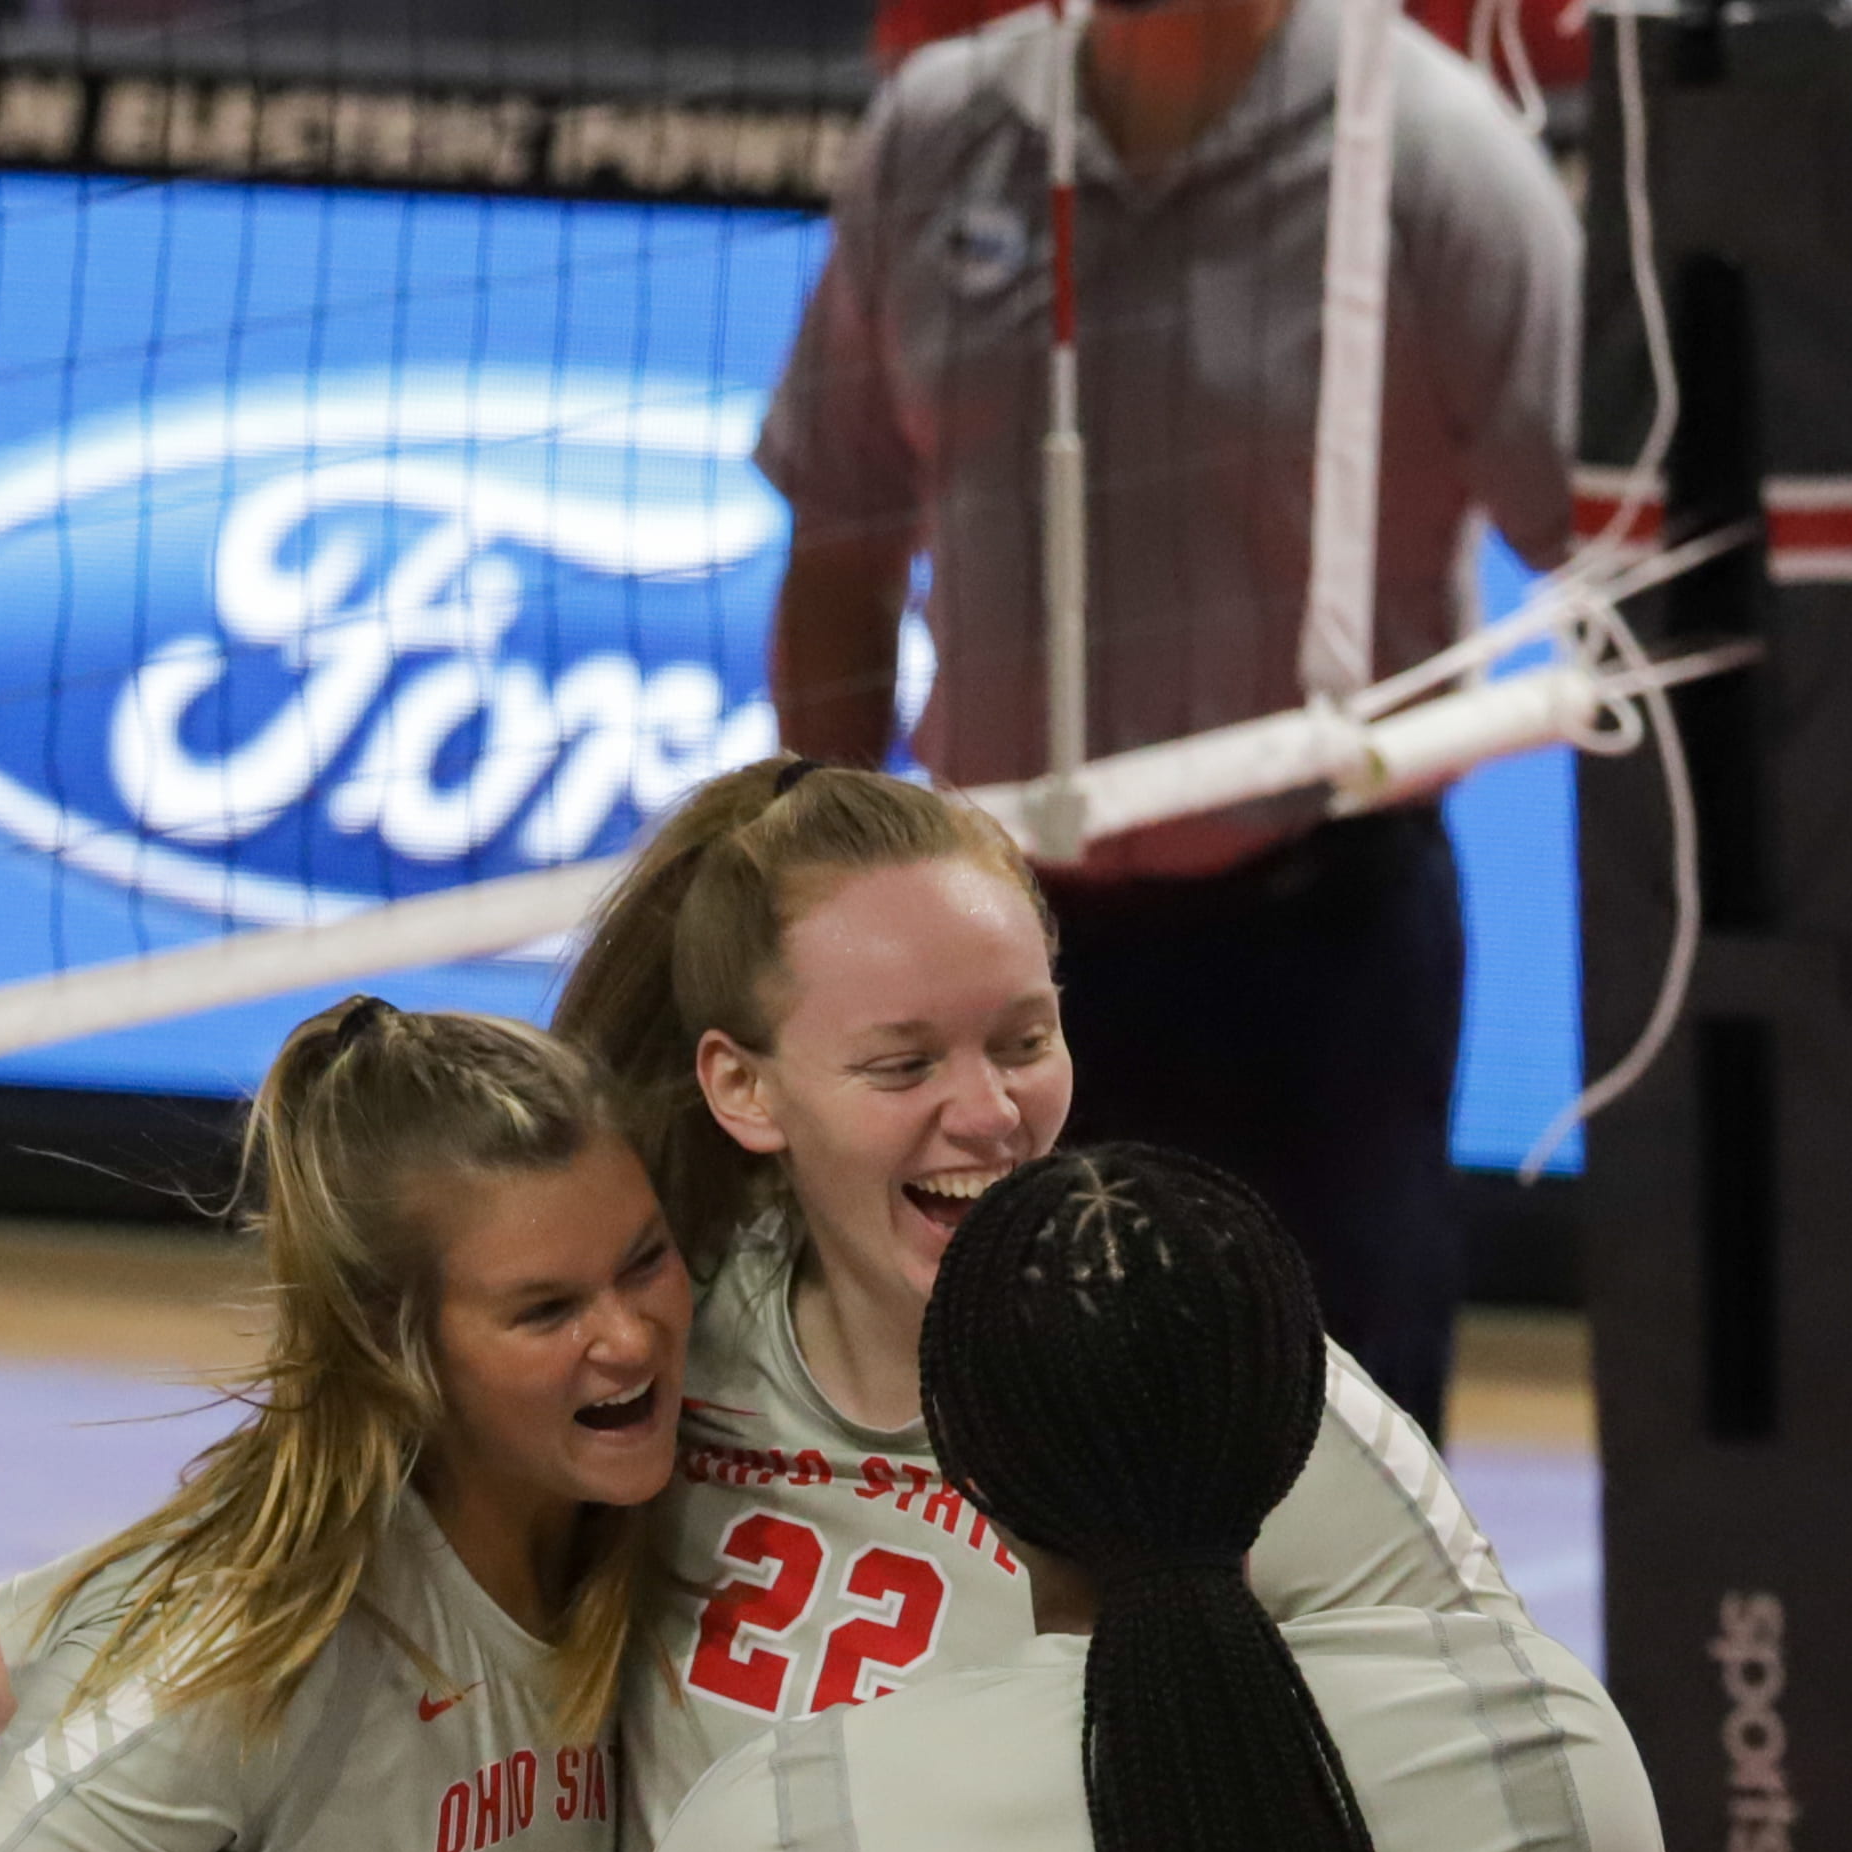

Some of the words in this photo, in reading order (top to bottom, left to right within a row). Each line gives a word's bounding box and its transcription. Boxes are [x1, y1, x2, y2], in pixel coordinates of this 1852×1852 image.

[95, 76, 535, 186] ELECTRIC
[549, 98, 854, 196] POWE
[682, 1506, 951, 1722] 22
[555, 1742, 621, 1823] STA
